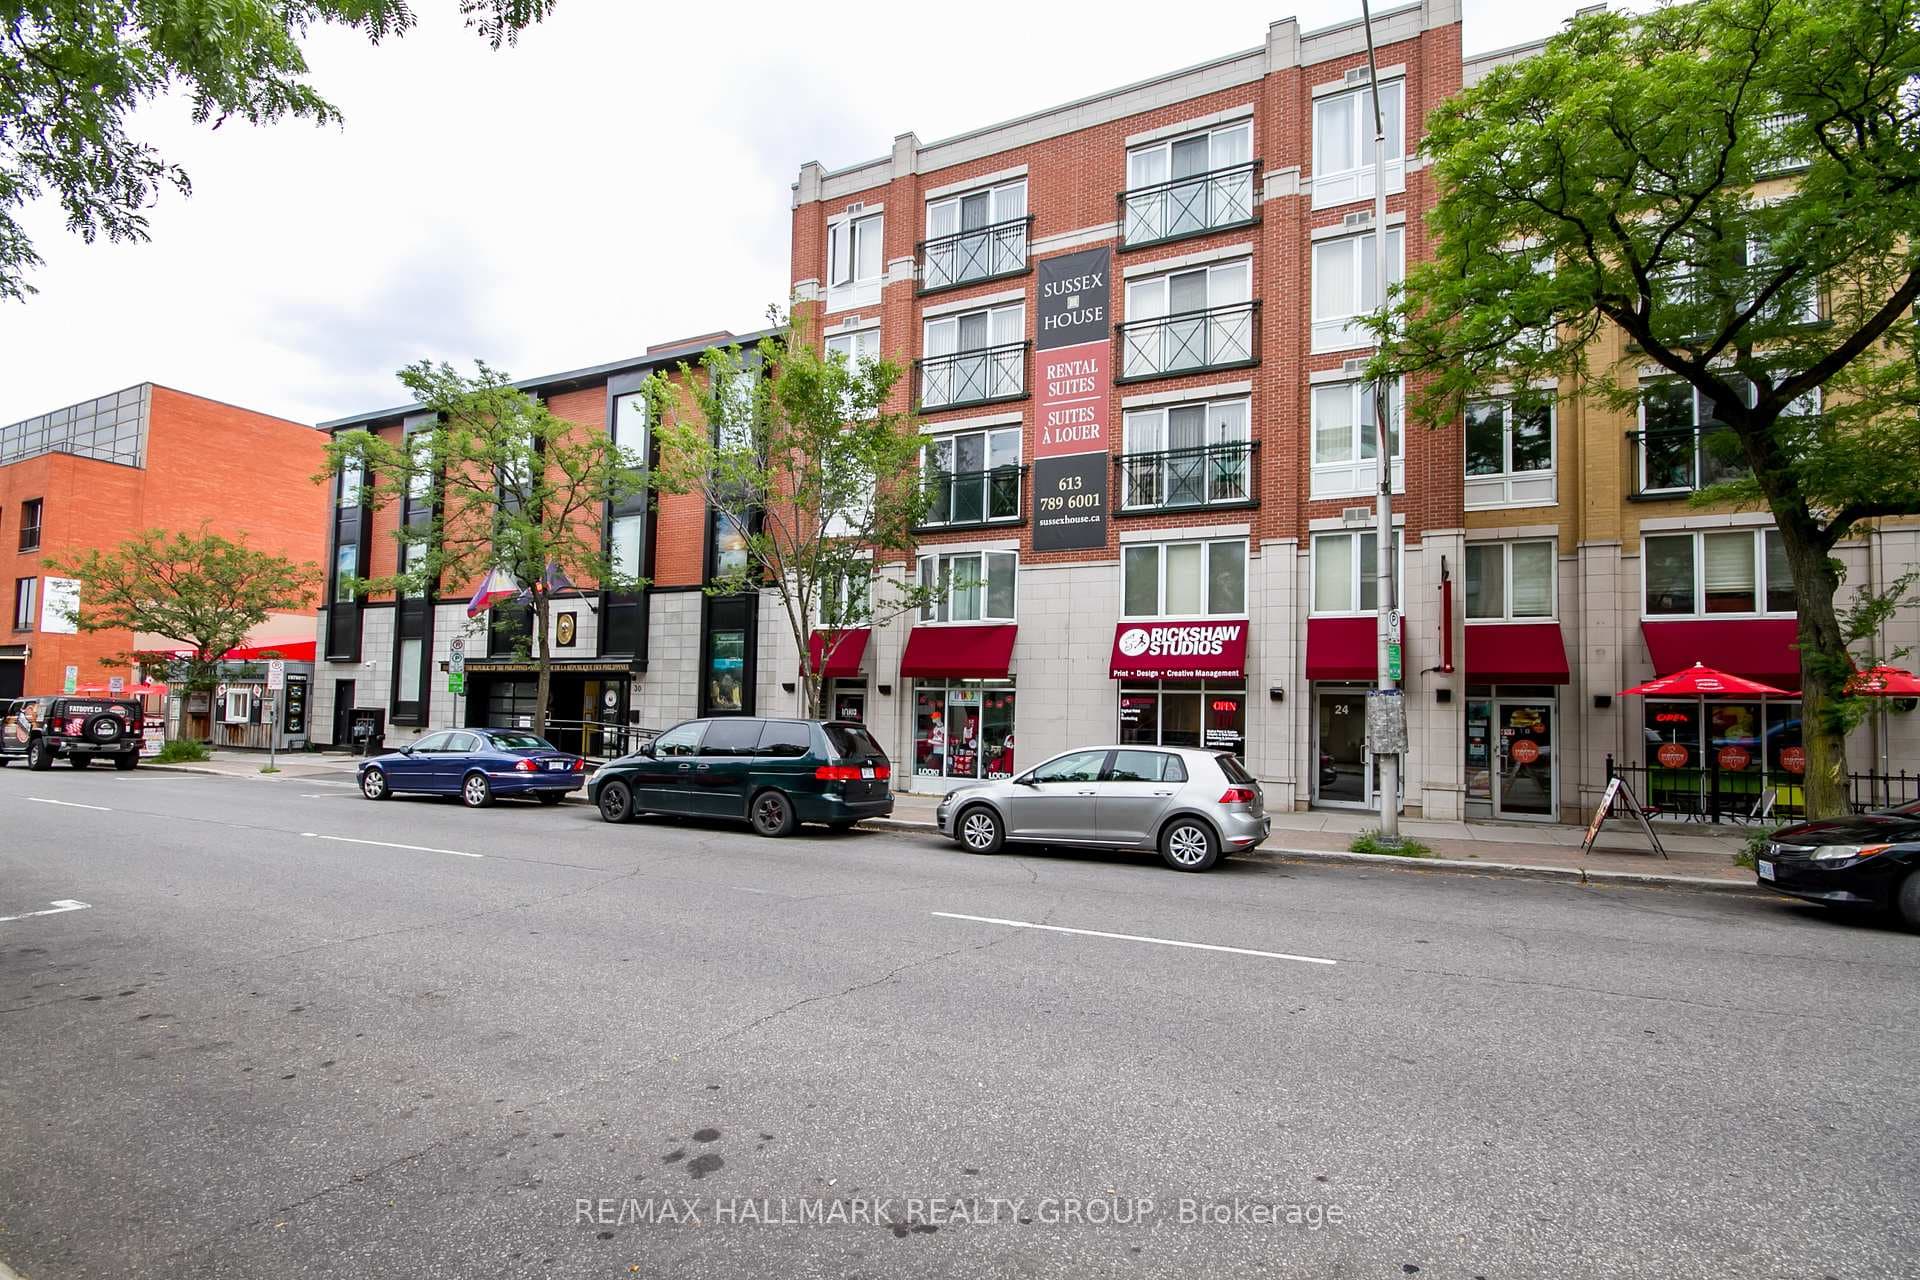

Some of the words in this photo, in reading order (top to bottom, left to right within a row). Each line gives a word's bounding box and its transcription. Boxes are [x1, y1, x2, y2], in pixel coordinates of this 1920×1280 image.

[1044, 272, 1103, 297] SUSSEX
[1044, 306, 1103, 330] HOUSE
[1047, 359, 1098, 379] RENTAL
[1048, 377, 1095, 397] SUITES
[1048, 406, 1094, 426] SUITES
[1042, 426, 1051, 445] À
[1055, 424, 1100, 443] LOUER
[1058, 476, 1082, 491] 613
[1040, 497, 1063, 511] 789
[1068, 493, 1101, 509] 6001
[1039, 514, 1101, 527] sussexhouse.ca
[1150, 626, 1240, 642] RICKSHAW
[1149, 640, 1222, 656] STUDIOS
[1113, 669, 1129, 677] Print
[1136, 669, 1159, 679] Design
[1195, 669, 1240, 678] Management
[1213, 701, 1237, 711] OPEN
[1335, 704, 1349, 715] 24
